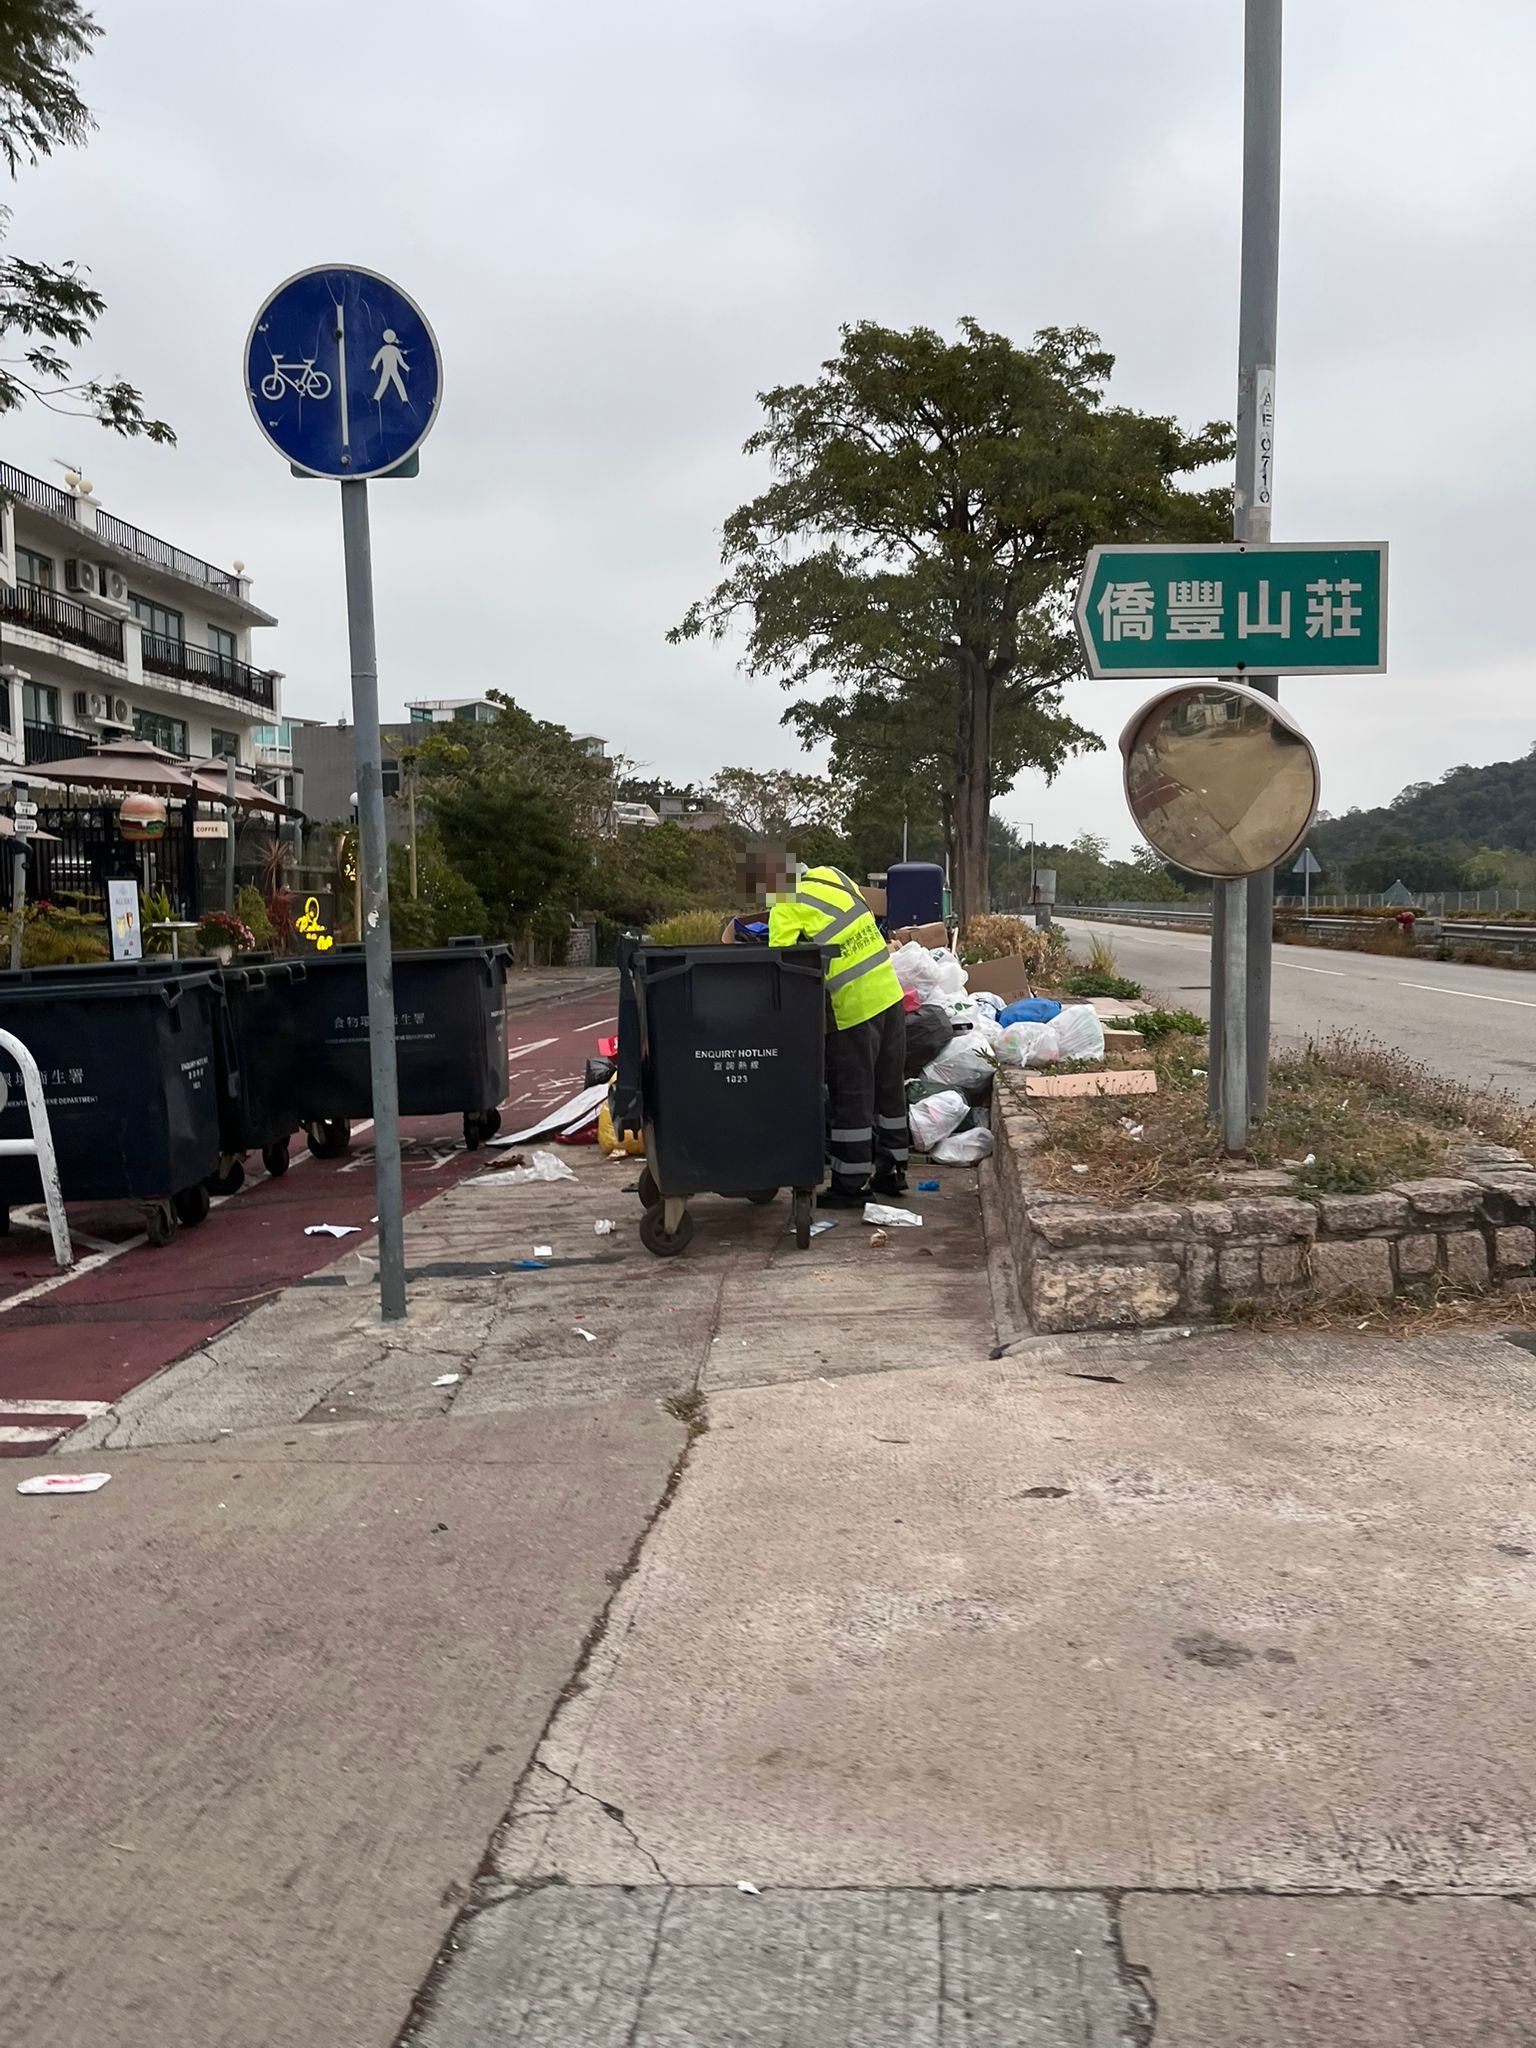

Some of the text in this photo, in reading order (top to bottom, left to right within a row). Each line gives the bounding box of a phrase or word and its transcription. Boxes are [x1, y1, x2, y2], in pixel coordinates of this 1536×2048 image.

[1097, 578, 1363, 642] 僑豐山莊
[695, 1048, 779, 1059] ENQUIRY HOTLINE
